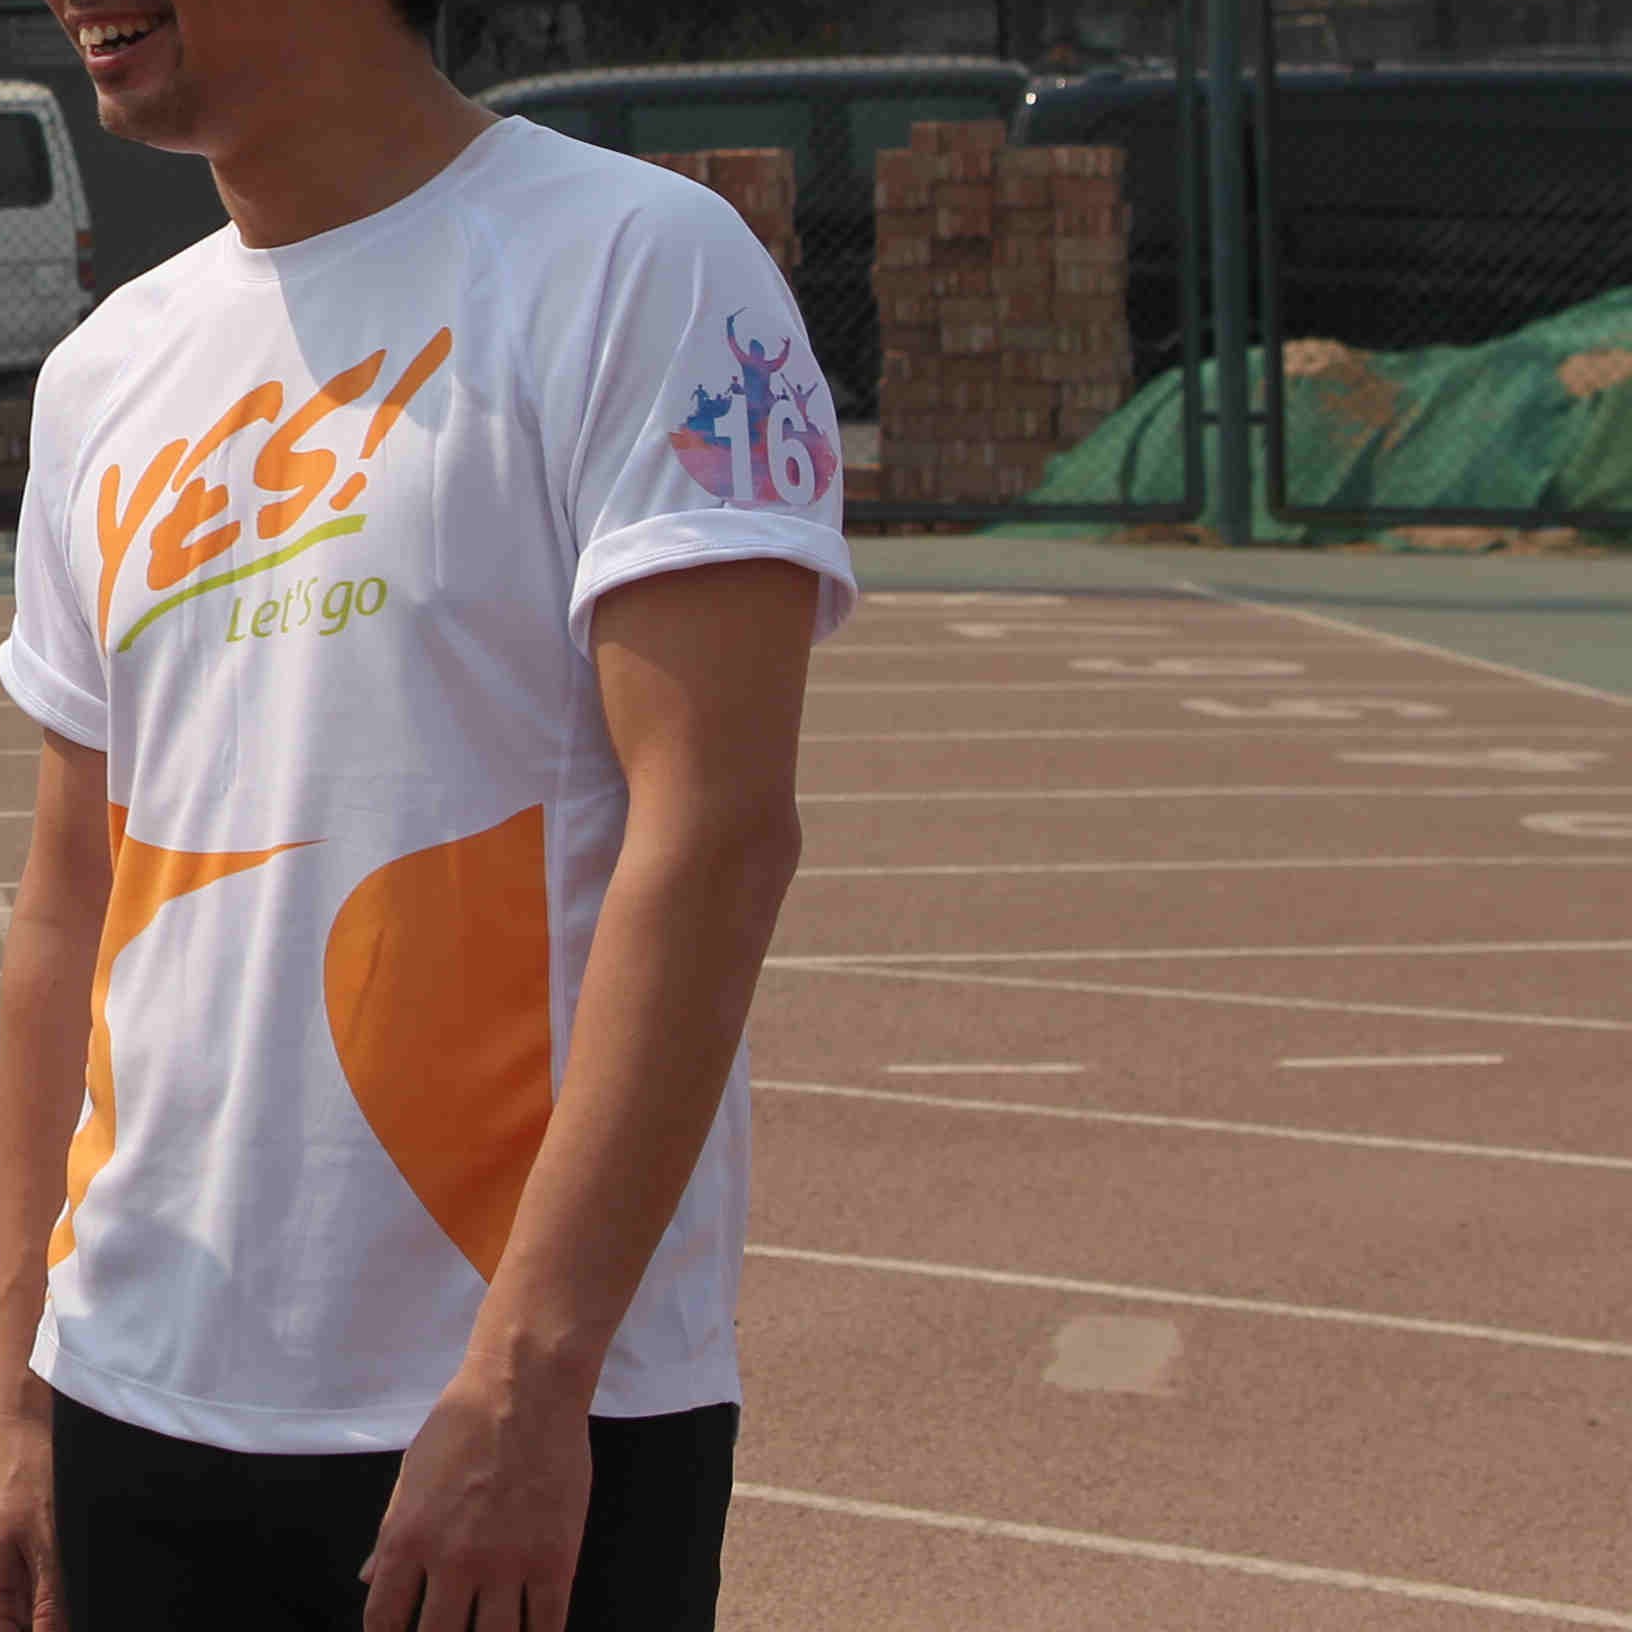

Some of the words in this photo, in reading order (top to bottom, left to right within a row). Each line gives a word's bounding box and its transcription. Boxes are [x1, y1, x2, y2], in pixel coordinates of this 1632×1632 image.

[96, 326, 453, 656] YES!
[714, 394, 817, 505] 16
[319, 576, 387, 636] go
